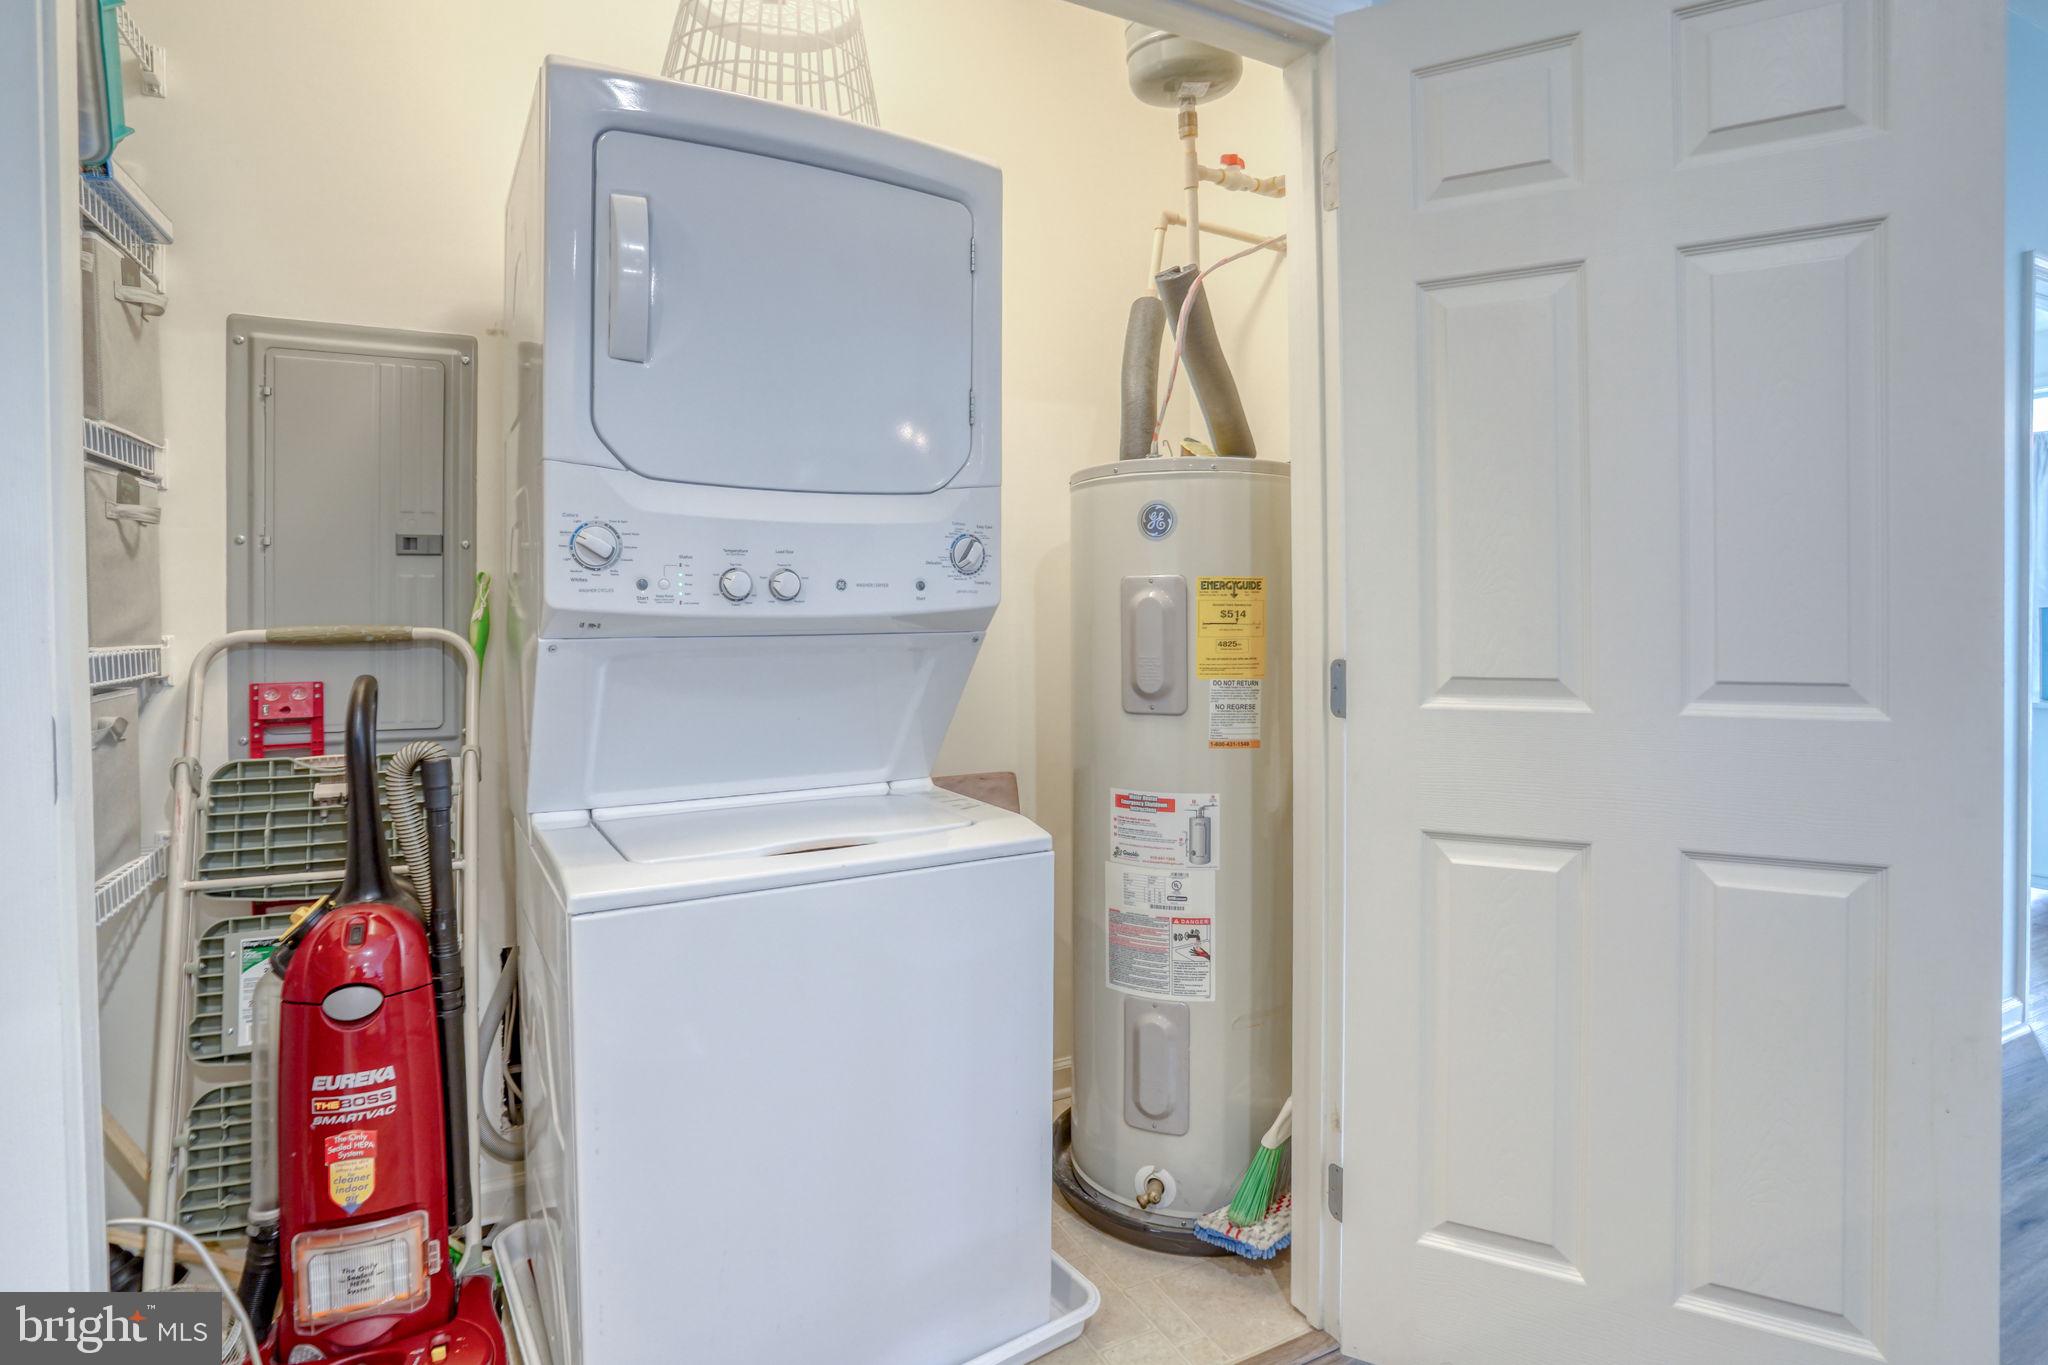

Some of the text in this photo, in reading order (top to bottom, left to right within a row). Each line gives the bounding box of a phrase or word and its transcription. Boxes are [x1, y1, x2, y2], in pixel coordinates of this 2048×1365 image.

[1200, 580, 1262, 591] ENERGYGUIDE
[1220, 609, 1247, 619] $514
[1217, 640, 1238, 648] 4825
[312, 1065, 397, 1091] EUREKA
[314, 1090, 393, 1111] THE BOSS
[311, 1104, 398, 1127] SMARTVAC
[334, 1132, 368, 1144] The Only
[327, 1141, 375, 1155] Sealed HEPA
[337, 1150, 364, 1160] System
[333, 1173, 370, 1185] cleaner
[335, 1183, 369, 1195] indoor
[345, 1193, 359, 1202] air
[342, 1263, 378, 1275] The Only
[346, 1271, 375, 1282] Sealed
[349, 1279, 371, 1287] HEPA
[346, 1285, 375, 1296] System
